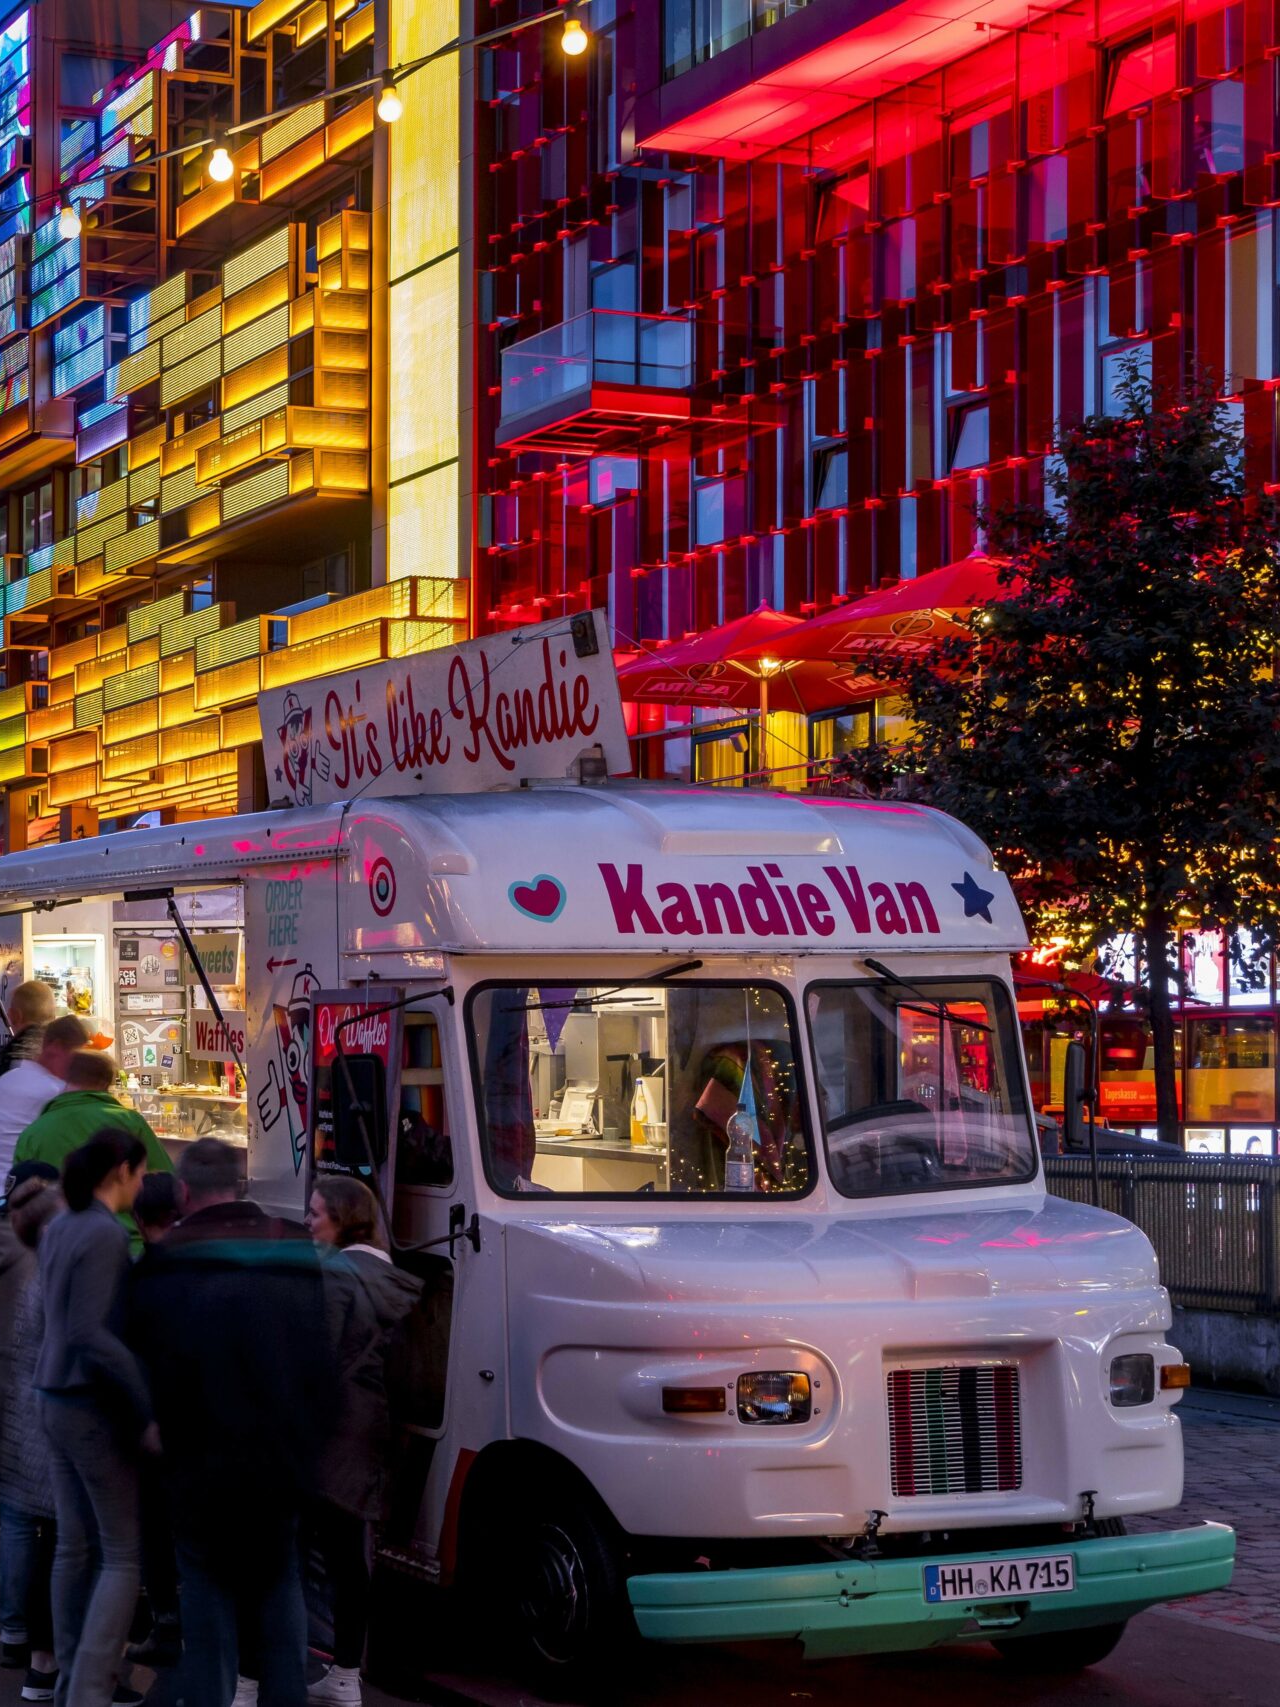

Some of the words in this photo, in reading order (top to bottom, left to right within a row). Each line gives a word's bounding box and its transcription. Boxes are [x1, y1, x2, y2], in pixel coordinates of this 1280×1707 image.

[324, 679, 383, 789] It's
[385, 674, 451, 773] like
[448, 638, 600, 771] Kandie
[265, 879, 303, 913] ORDER
[268, 913, 299, 947] HERE
[195, 1021, 245, 1053] Waffles
[940, 1567, 974, 1596] HH
[989, 1564, 1022, 1592] KA
[1026, 1560, 1070, 1589] 715
